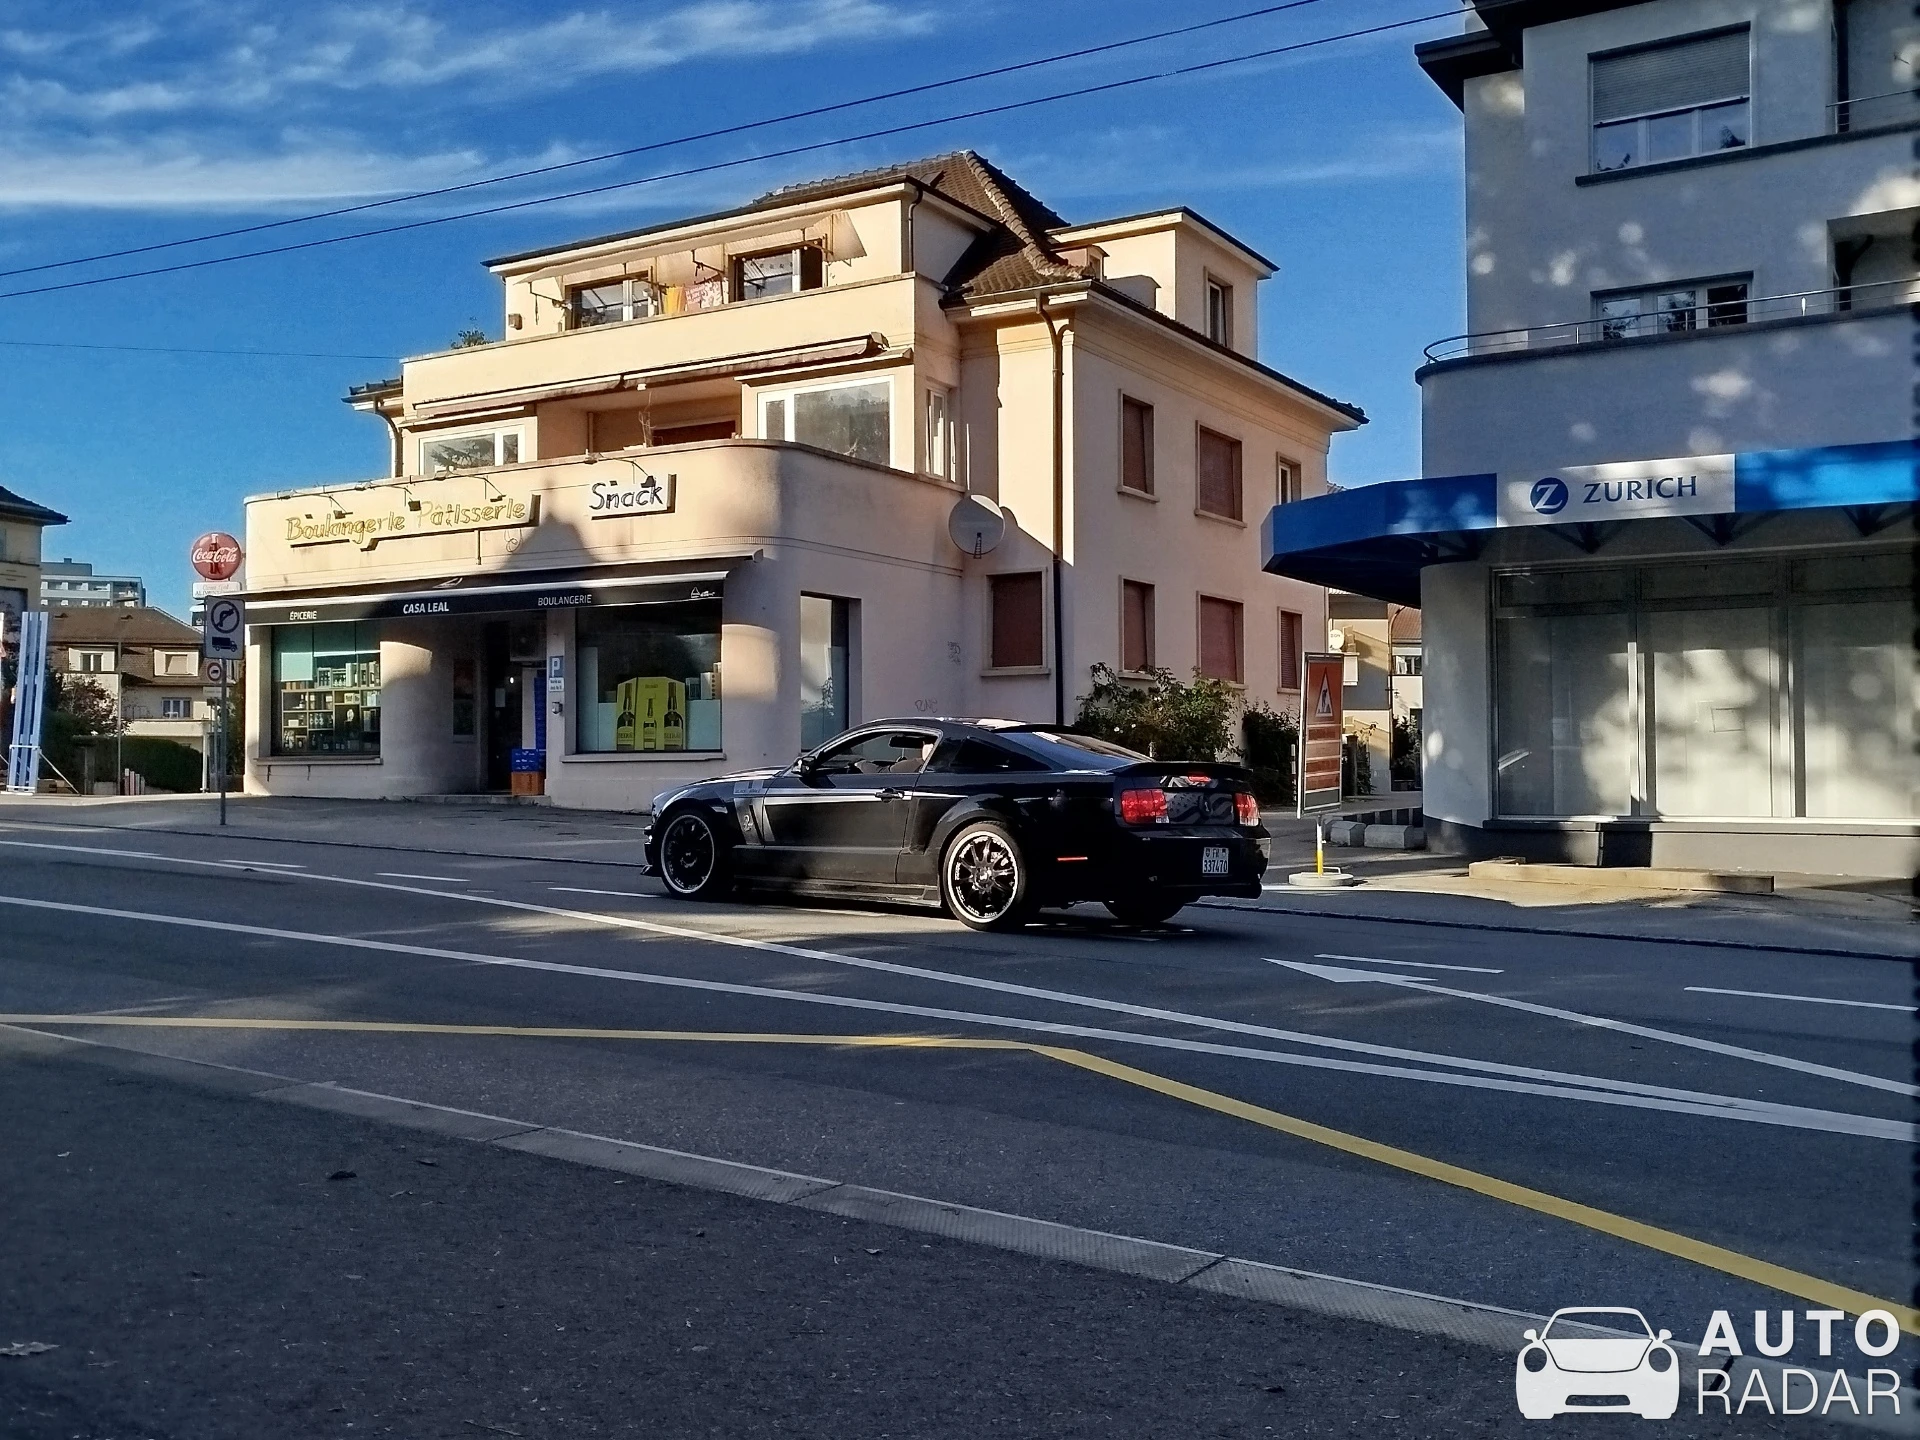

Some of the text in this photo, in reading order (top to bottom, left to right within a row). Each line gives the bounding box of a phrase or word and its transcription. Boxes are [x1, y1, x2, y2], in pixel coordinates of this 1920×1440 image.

[589, 482, 664, 511] Snack
[1582, 475, 1698, 504] ZURICH
[285, 510, 406, 545] Boulangerie
[402, 601, 450, 614] CASA LEAL
[537, 594, 592, 606] BOULANGERIE
[289, 610, 318, 621] ÉPICERIE
[551, 657, 561, 678] P
[1203, 859, 1228, 873] 337470
